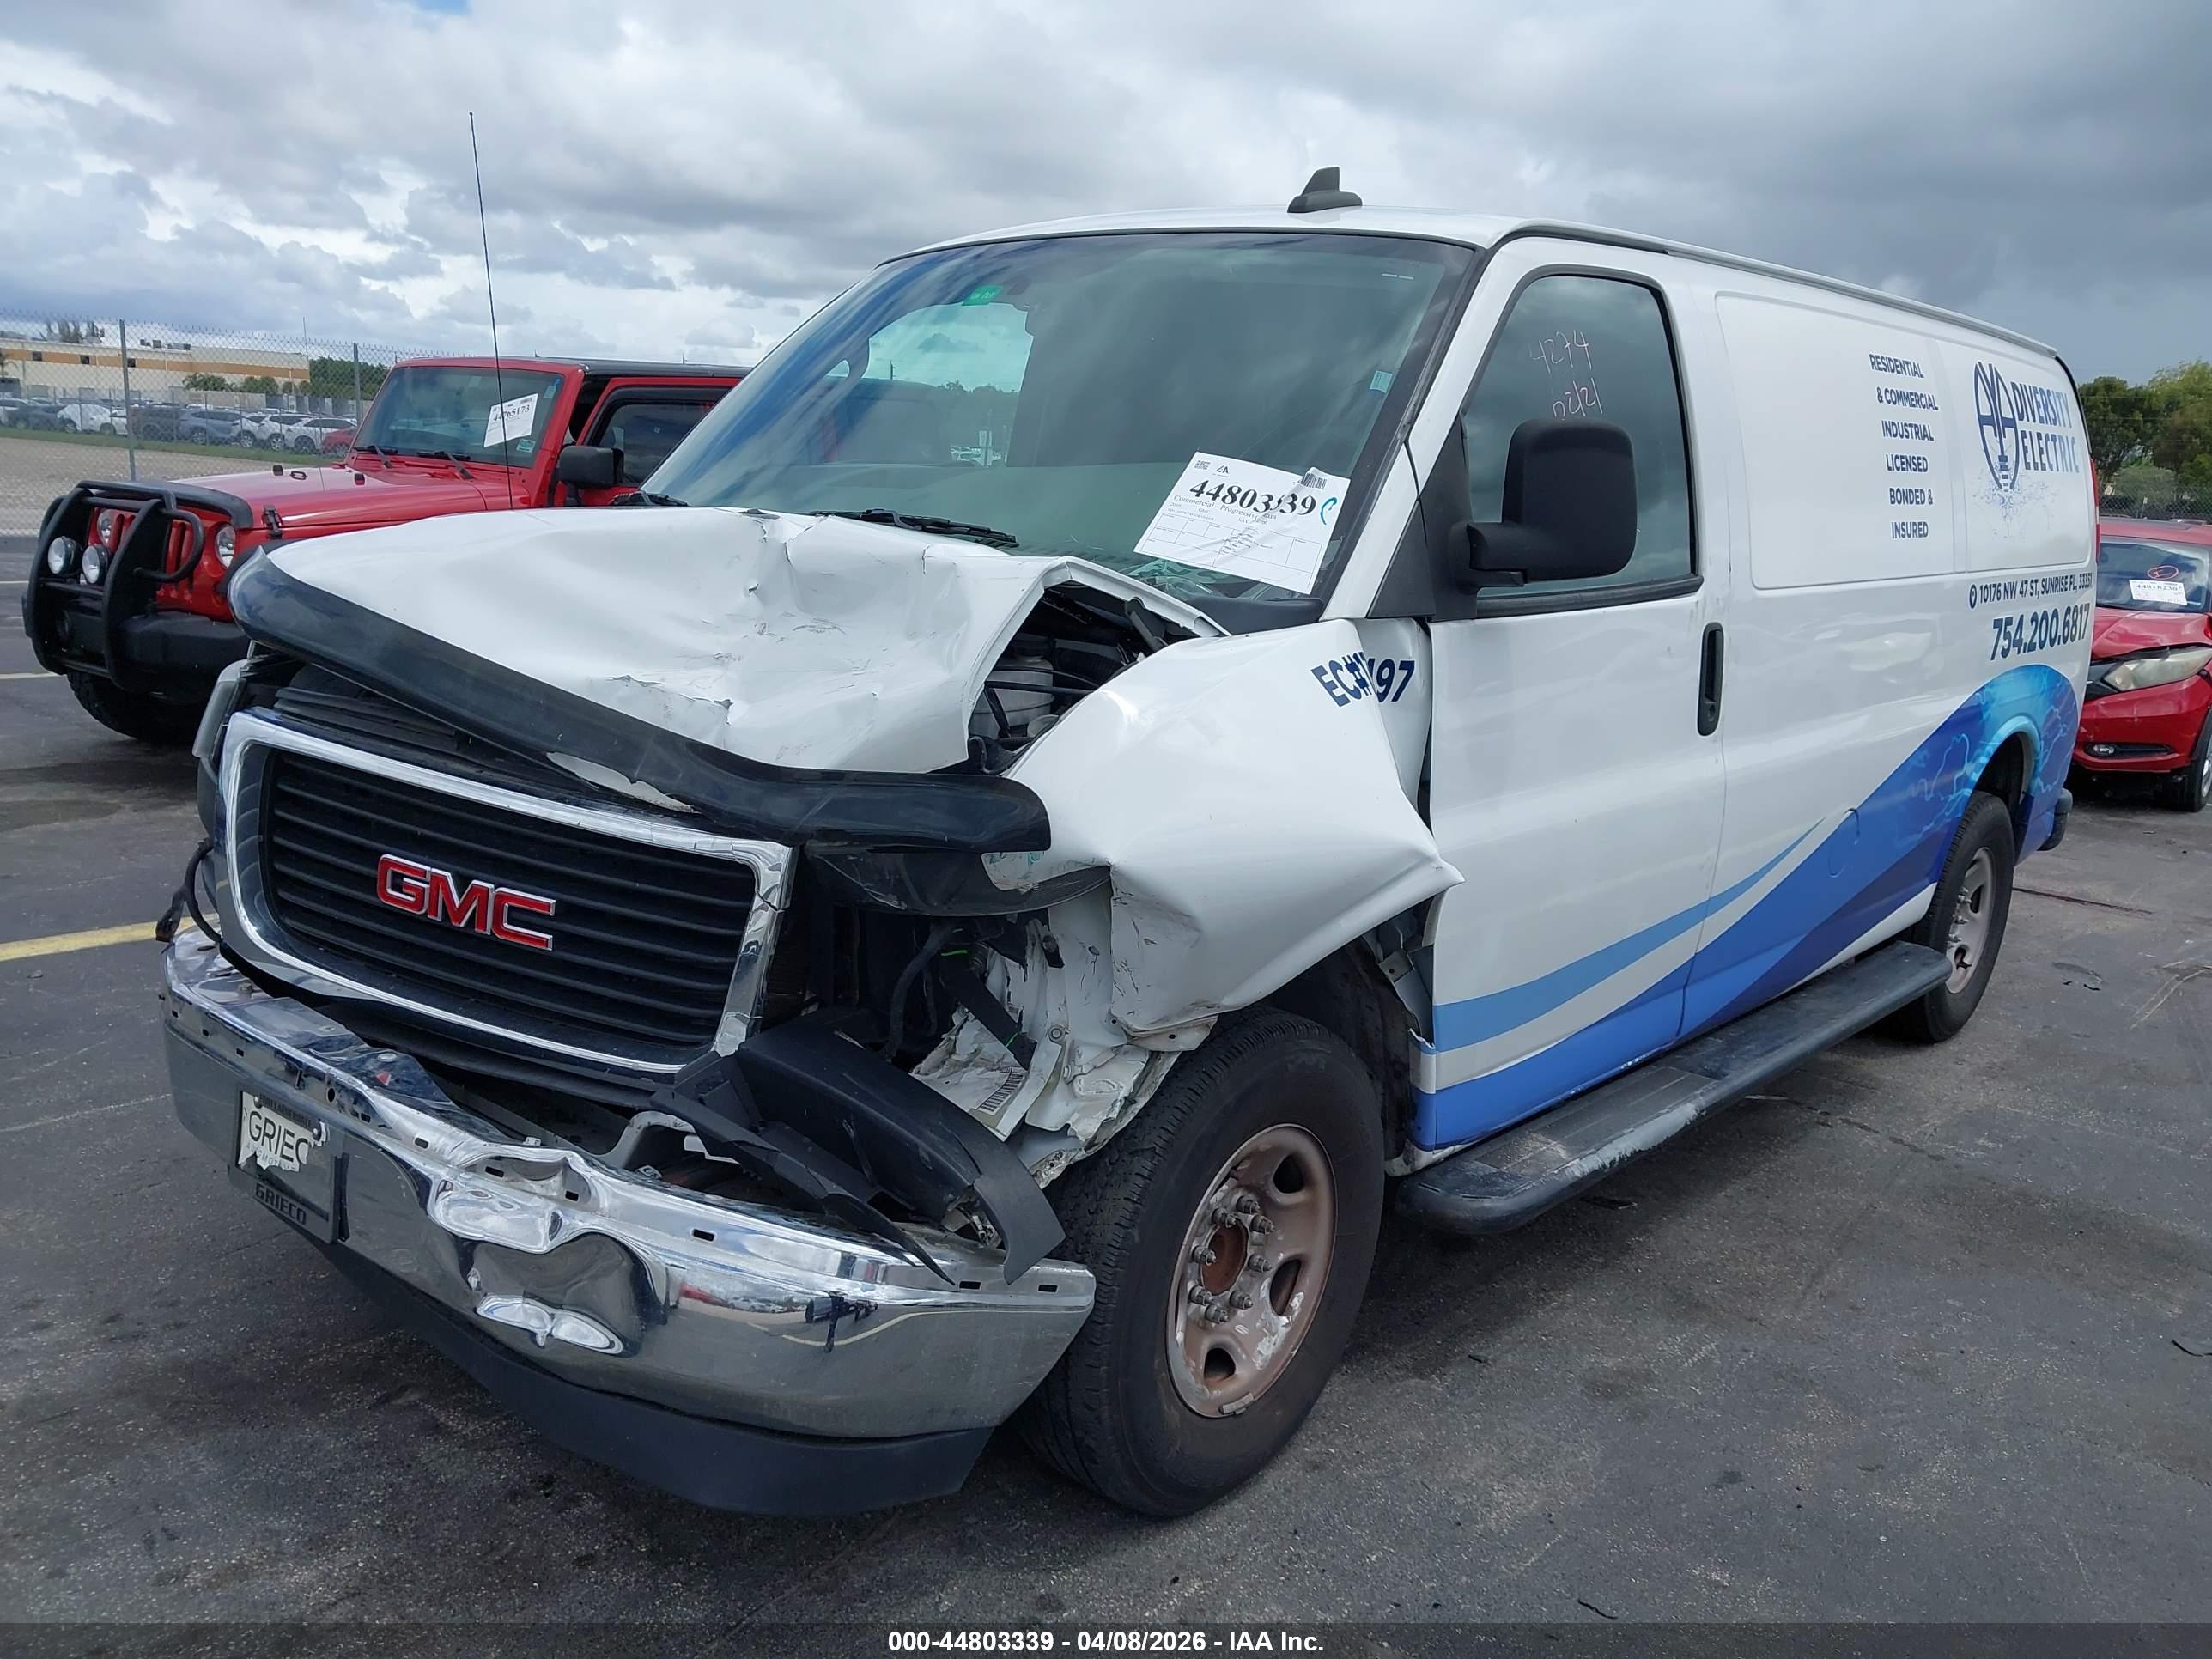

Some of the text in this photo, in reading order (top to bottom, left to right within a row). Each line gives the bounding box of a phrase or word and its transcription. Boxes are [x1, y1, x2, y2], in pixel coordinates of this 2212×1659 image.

[1869, 353, 1924, 378] RESIDENTIAL
[1876, 386, 1939, 410] & COMMERCIAL
[2010, 381, 2073, 428] DIVERSITY
[1881, 420, 1935, 441] INDUSTRIAL
[1886, 453, 1929, 473] LICENSED
[2020, 429, 2080, 473] ELECTRIC
[1889, 487, 1934, 505] BONDED &
[1891, 521, 1929, 538] INSURED
[1979, 582, 2002, 604] 10176
[2003, 580, 2018, 600] NW
[2019, 580, 2028, 598] 47
[2030, 578, 2039, 599] ST,
[2041, 575, 2069, 595] SUNRISE
[2069, 574, 2078, 593] FL,
[1990, 603, 2091, 660] 754.200.6817
[377, 854, 556, 951] GMC
[256, 1182, 307, 1226] GRIECO
